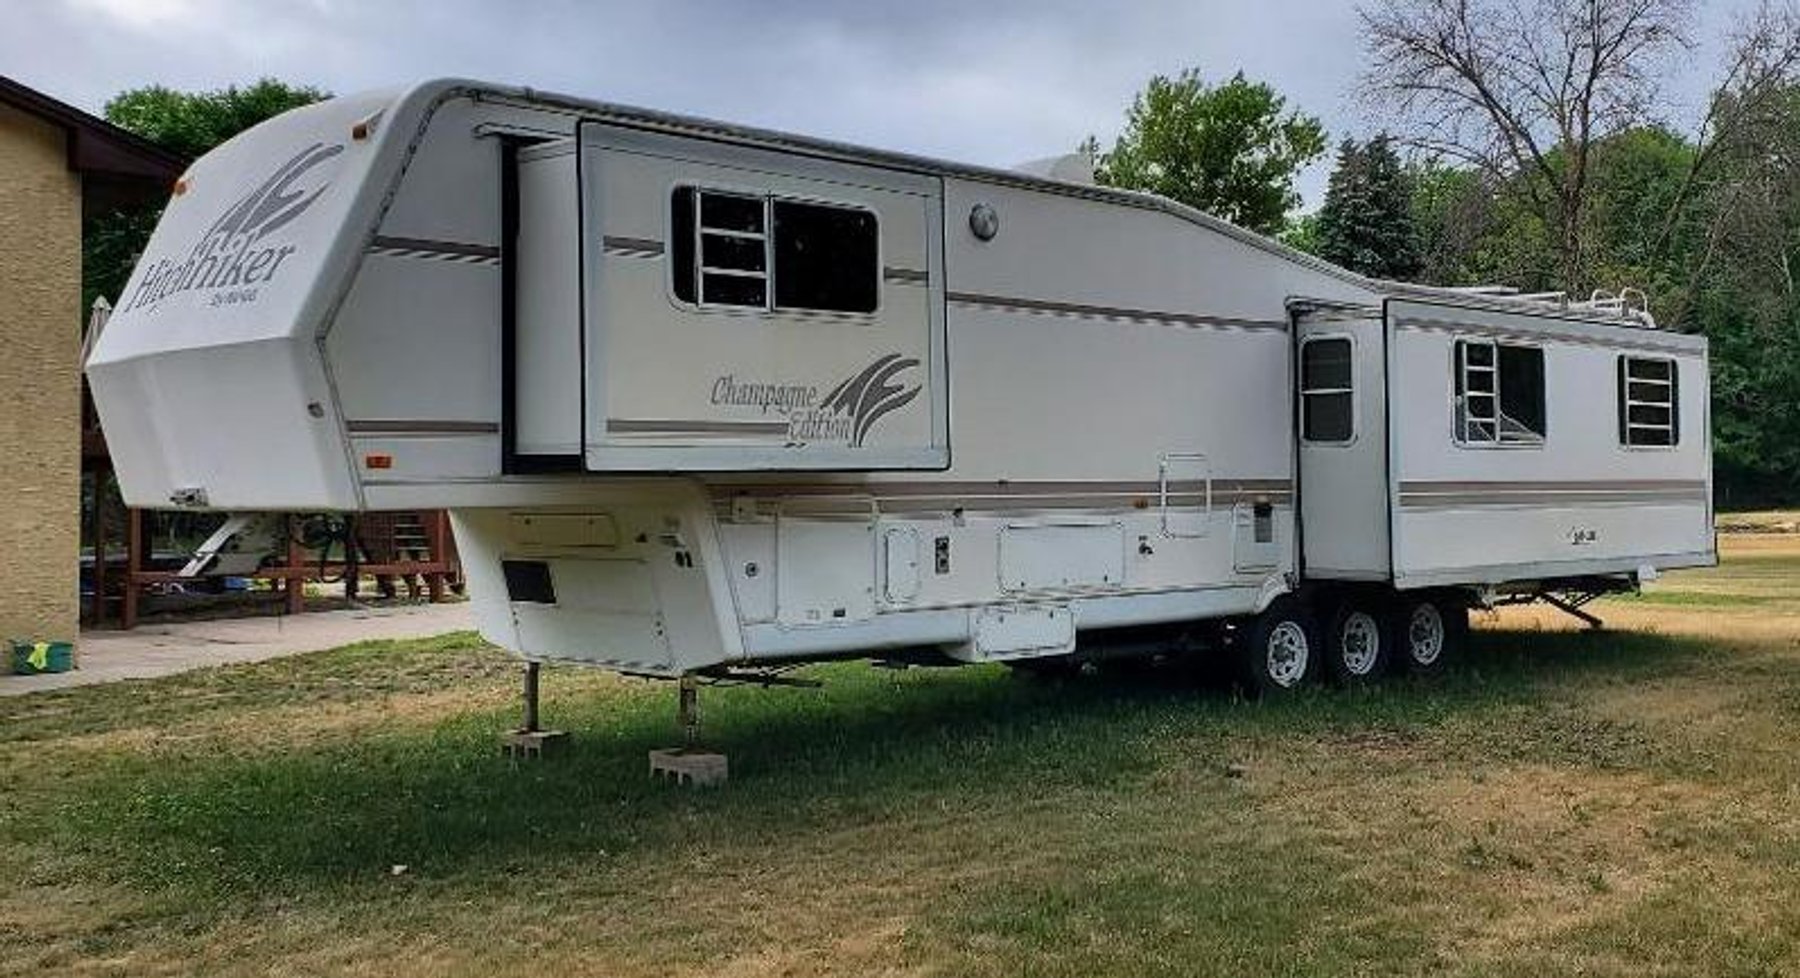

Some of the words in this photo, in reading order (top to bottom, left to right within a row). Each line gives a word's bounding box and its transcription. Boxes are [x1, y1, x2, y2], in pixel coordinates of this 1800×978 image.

[124, 237, 296, 313] Hitchhiker
[710, 374, 818, 414] Champagne
[787, 409, 850, 441] Edition
